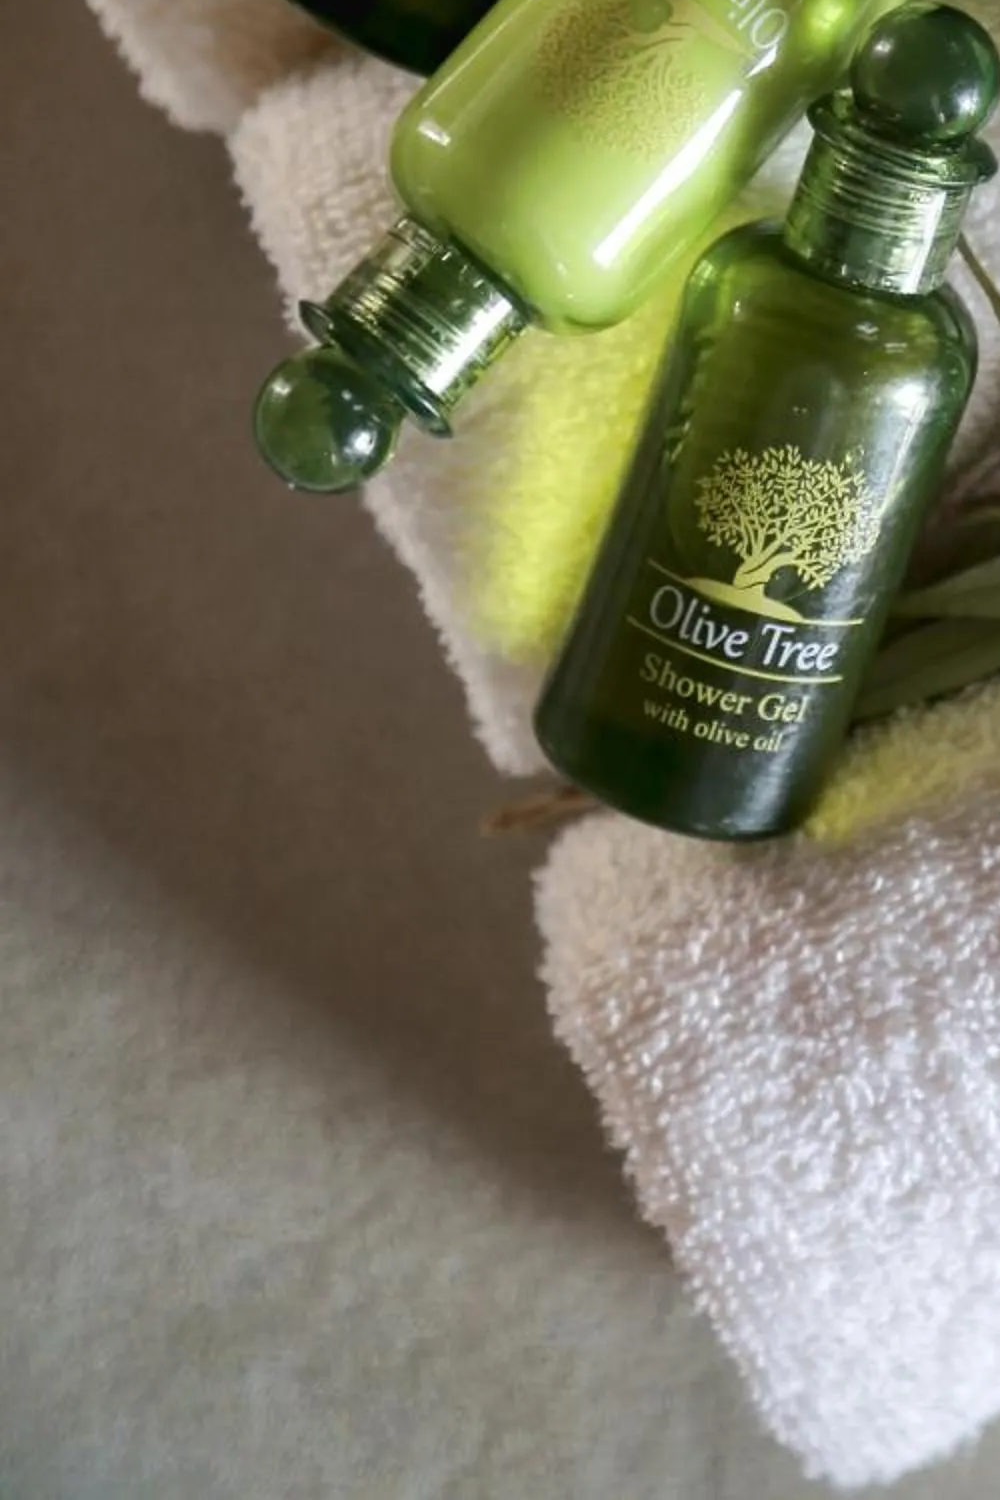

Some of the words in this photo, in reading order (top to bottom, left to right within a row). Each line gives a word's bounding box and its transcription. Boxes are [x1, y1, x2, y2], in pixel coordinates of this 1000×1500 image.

[649, 584, 749, 658] Olive
[761, 622, 840, 672] Tree
[638, 652, 752, 716] Shower
[757, 692, 811, 724] Gel
[643, 698, 690, 733] with
[693, 719, 751, 749] olive
[753, 731, 784, 753] oil
